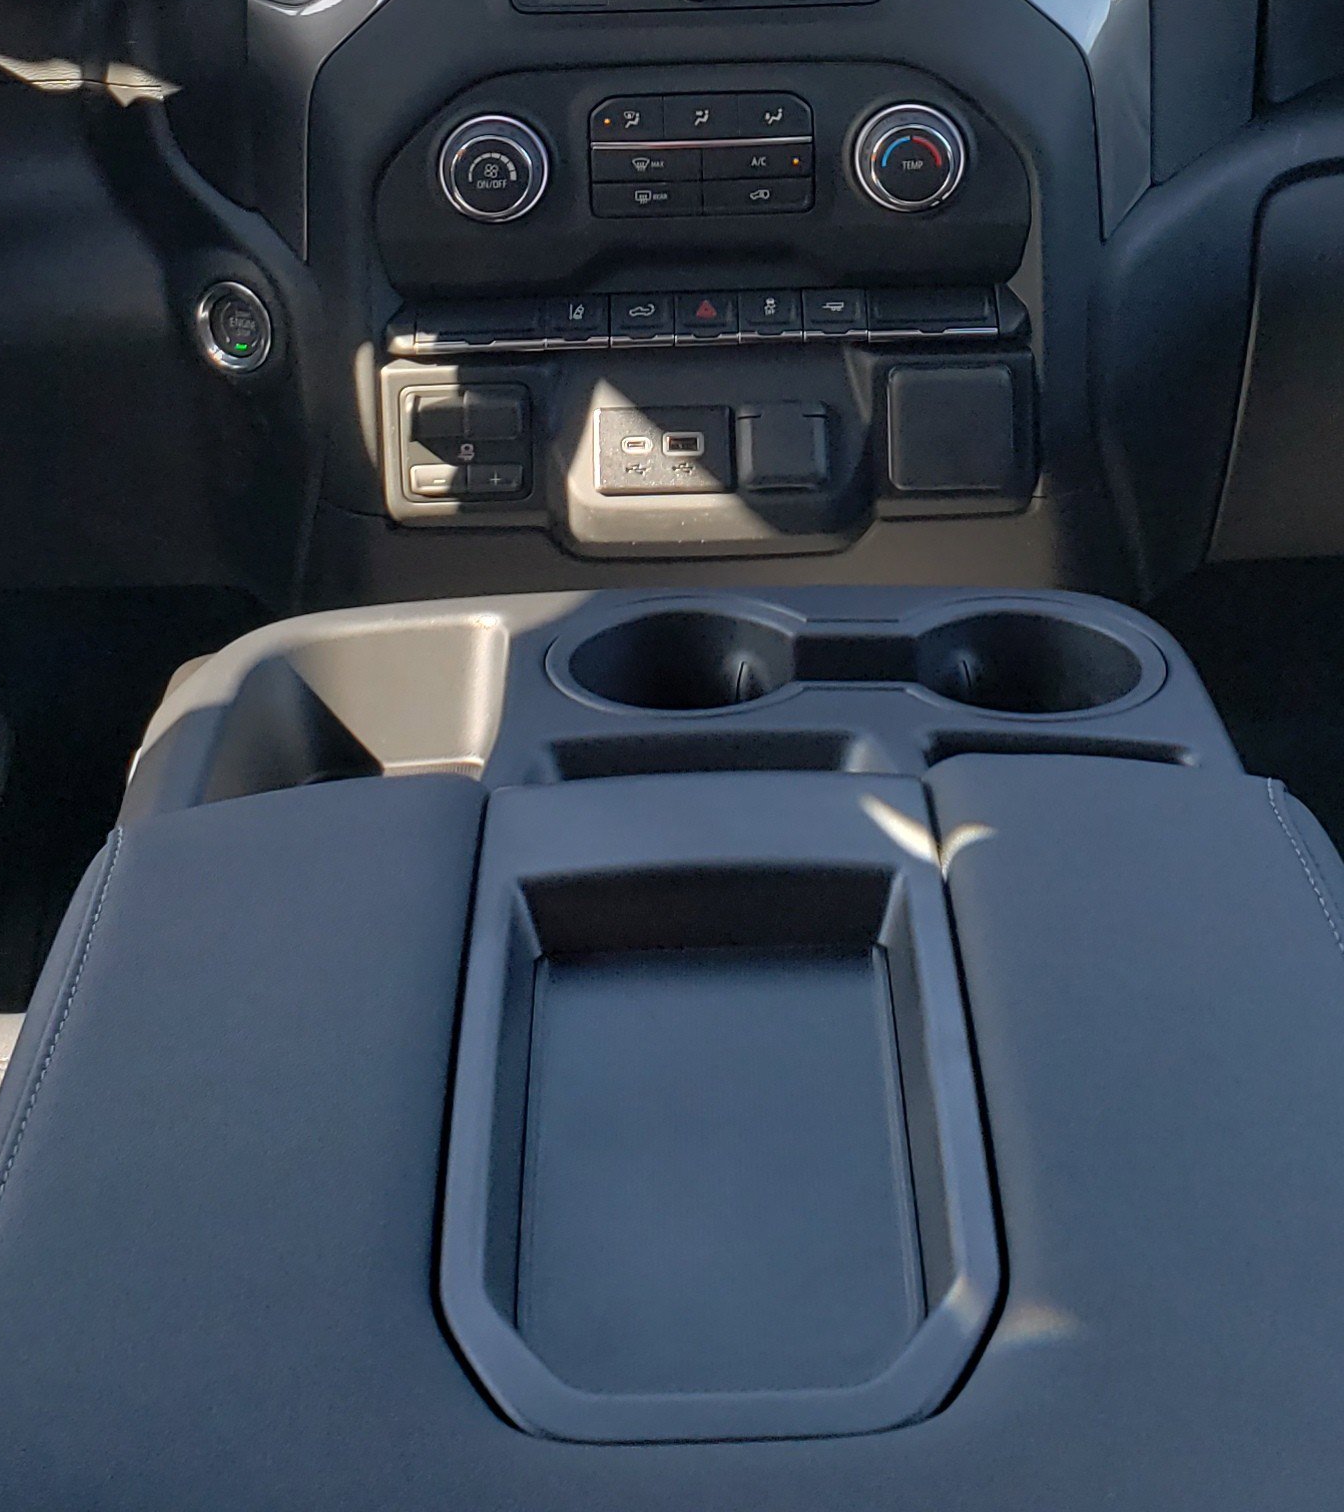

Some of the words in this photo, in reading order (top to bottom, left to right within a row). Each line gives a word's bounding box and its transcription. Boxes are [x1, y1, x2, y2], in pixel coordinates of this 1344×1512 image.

[650, 160, 665, 169] MAX
[750, 155, 767, 168] A/C
[901, 160, 925, 171] TEMP
[476, 179, 508, 190] ON/OFF
